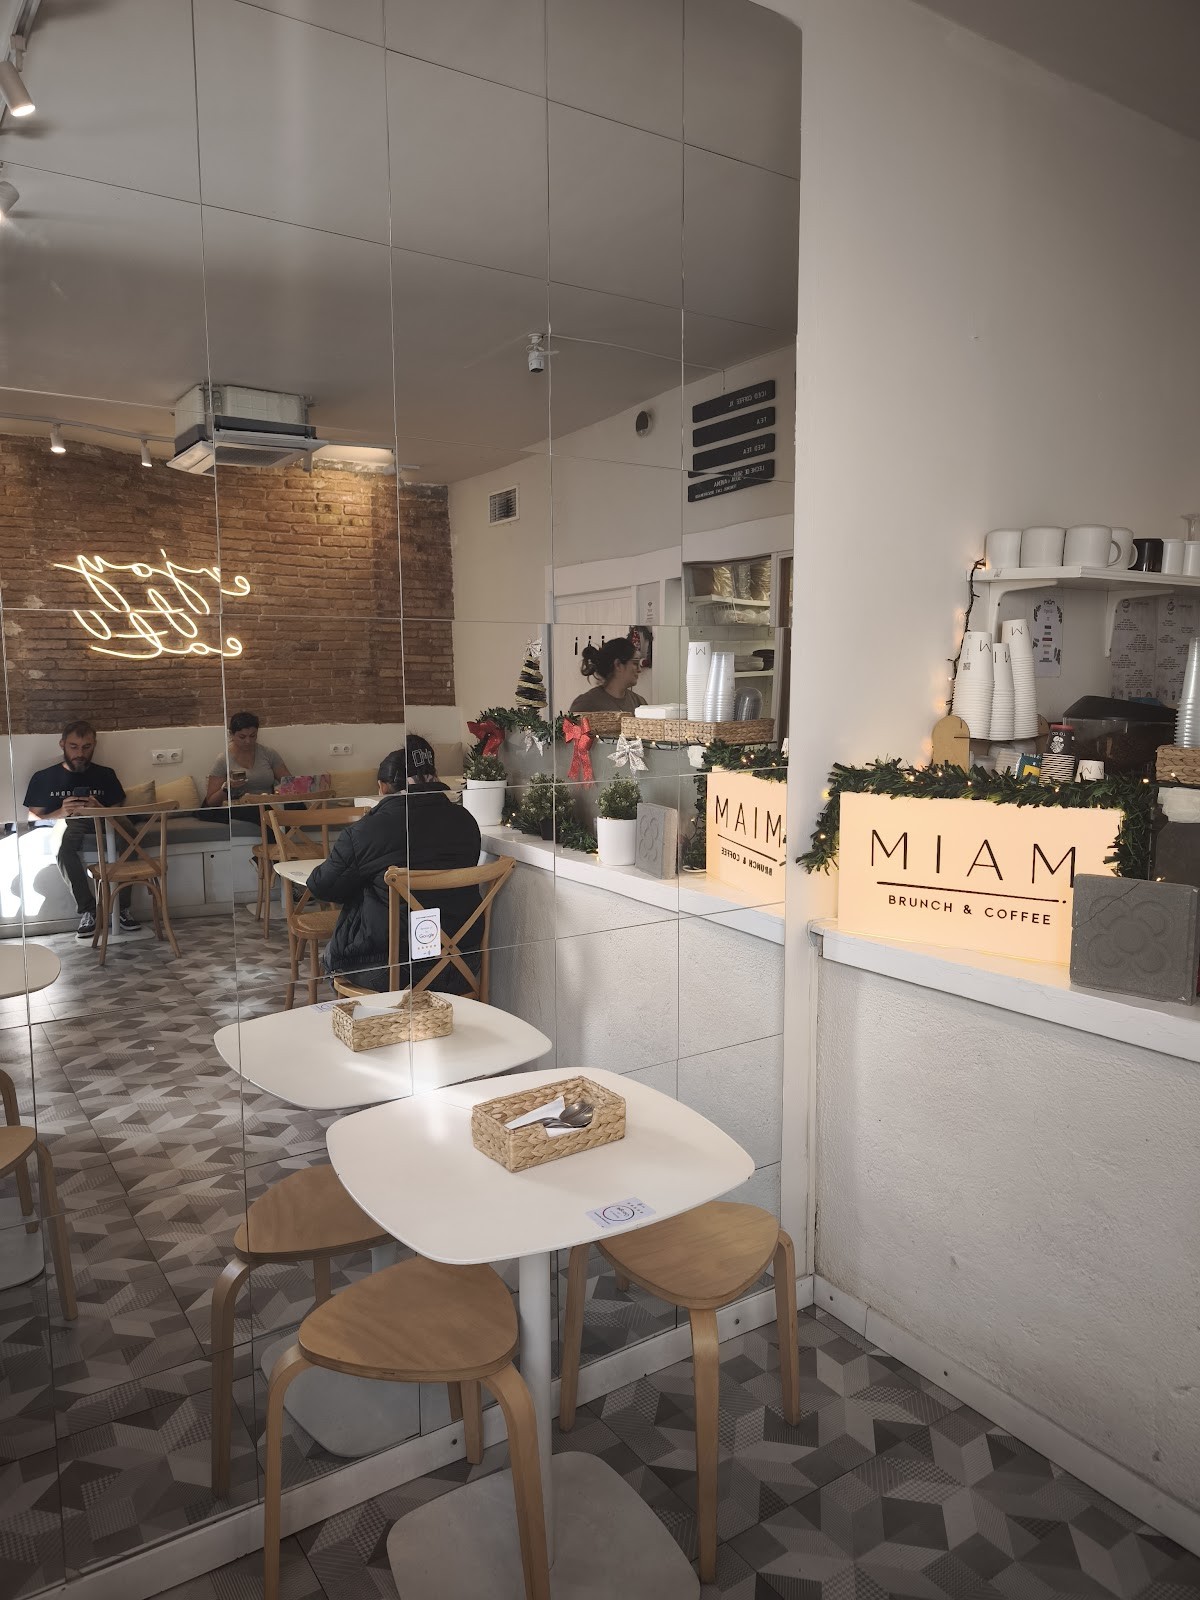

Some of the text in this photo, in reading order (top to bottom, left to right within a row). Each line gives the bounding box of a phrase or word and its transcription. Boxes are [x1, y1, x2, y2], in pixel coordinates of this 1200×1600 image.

[870, 828, 1076, 889] MIAM
[887, 893, 1052, 926] BRUNCH & COFFEE
